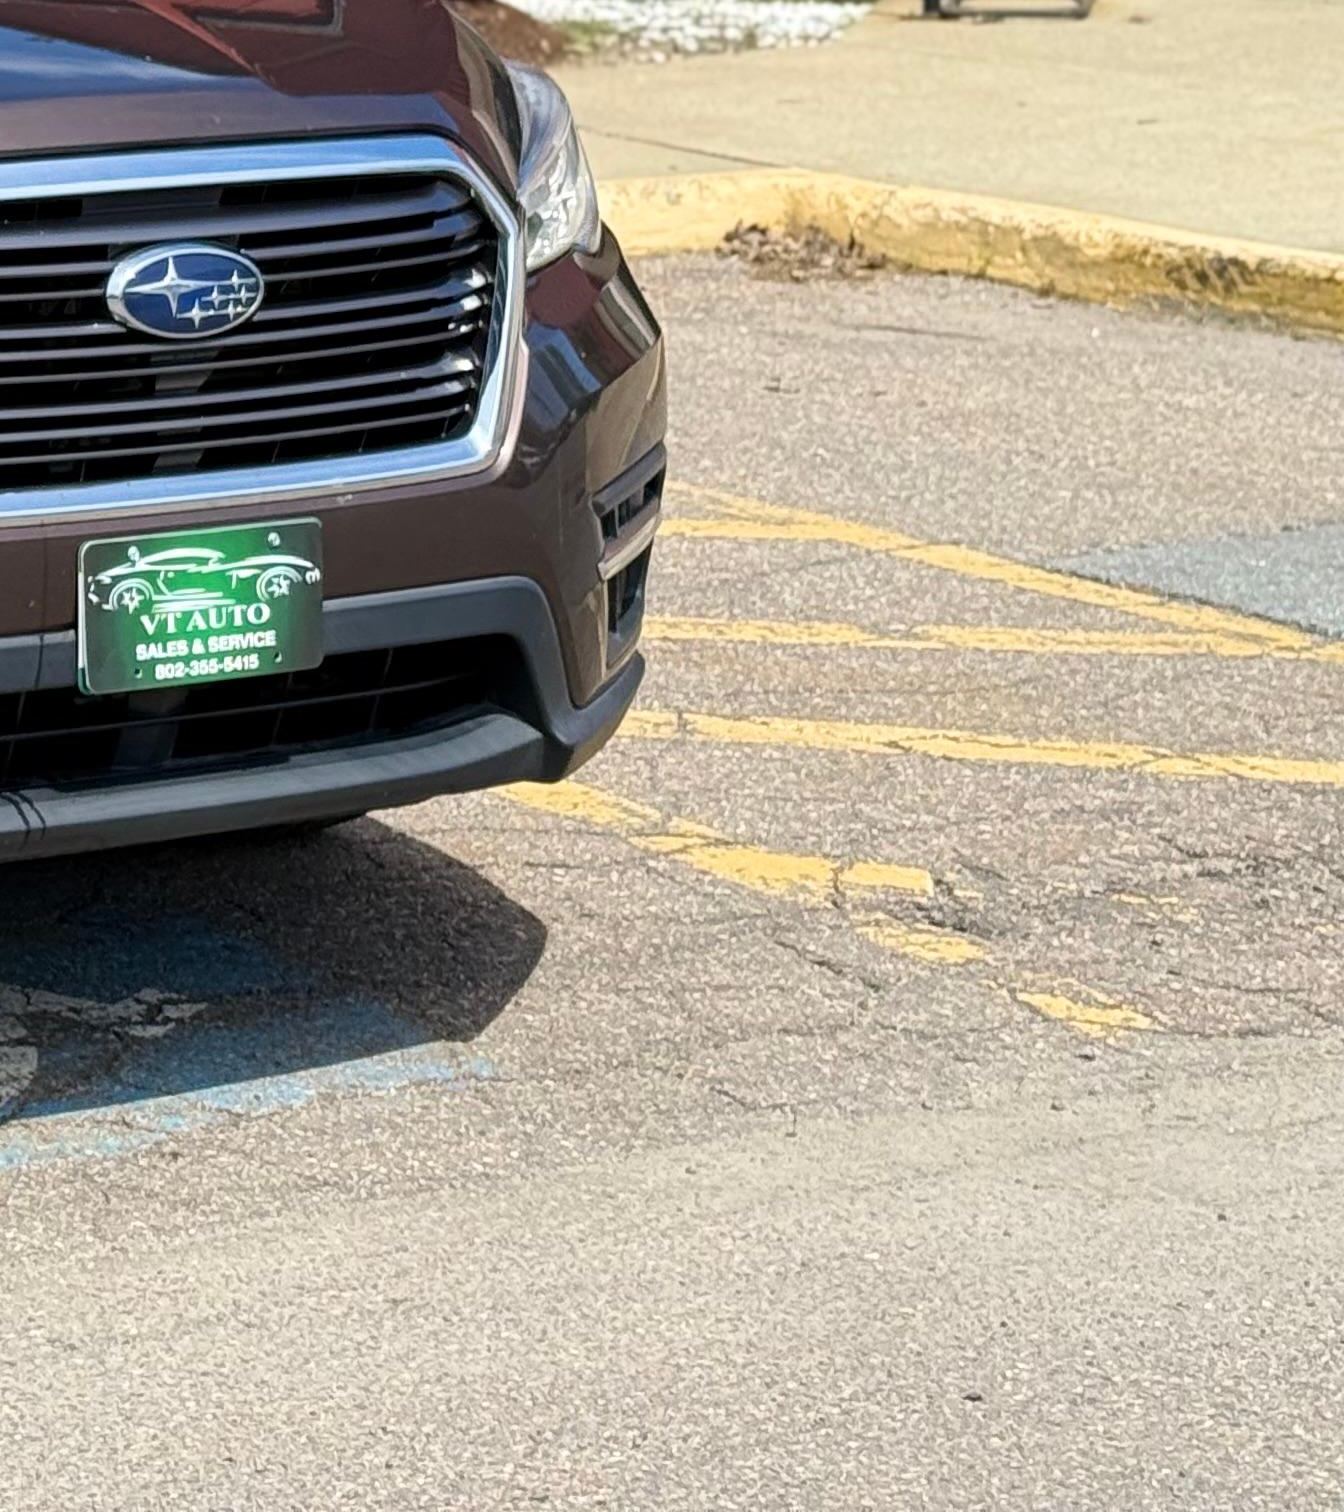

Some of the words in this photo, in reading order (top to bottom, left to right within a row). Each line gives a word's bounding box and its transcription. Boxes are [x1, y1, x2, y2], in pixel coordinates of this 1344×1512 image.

[140, 613, 182, 635] VT
[186, 603, 271, 631] AUTO
[135, 639, 188, 661] SALES
[191, 638, 205, 655] &
[208, 630, 277, 652] SERVICE
